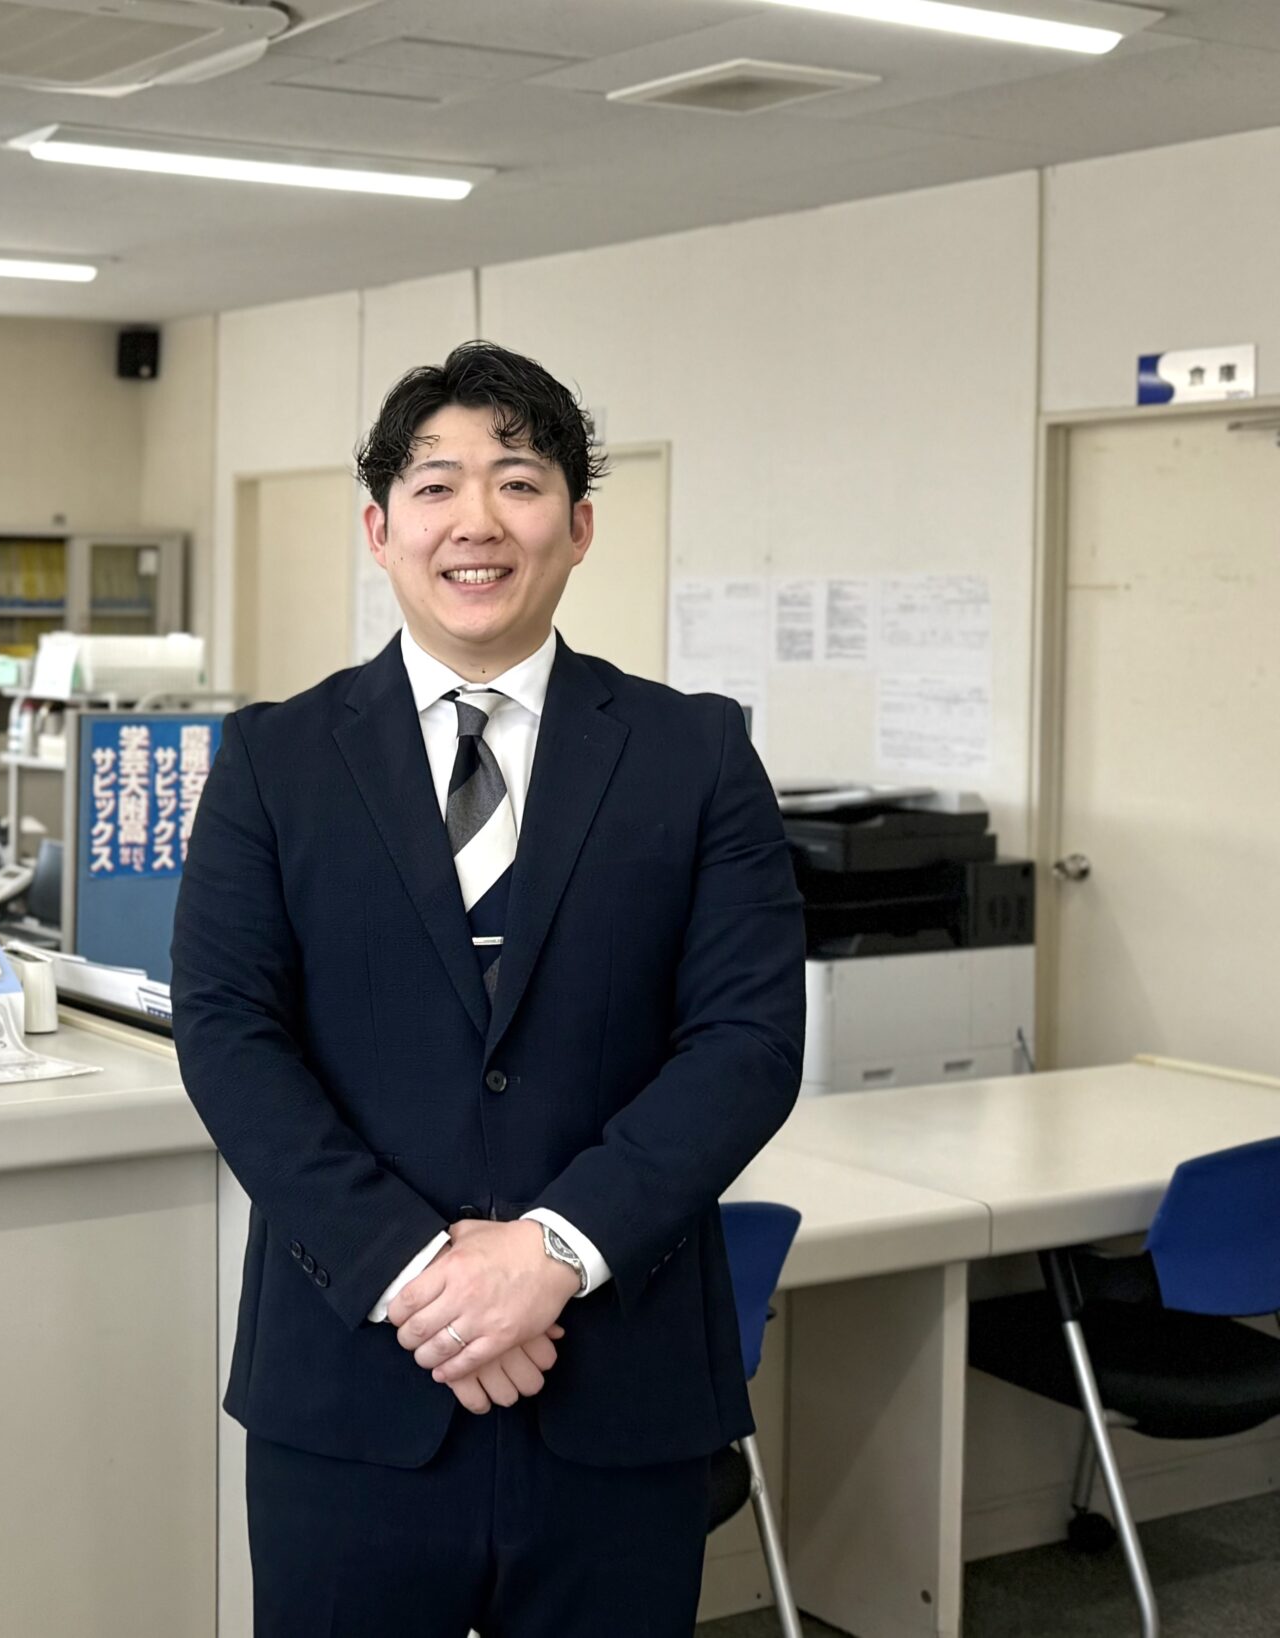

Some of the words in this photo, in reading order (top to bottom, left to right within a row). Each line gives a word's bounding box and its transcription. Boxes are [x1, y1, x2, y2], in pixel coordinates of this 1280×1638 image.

[90, 747, 117, 873] サピックス
[152, 746, 178, 871] サピックス
